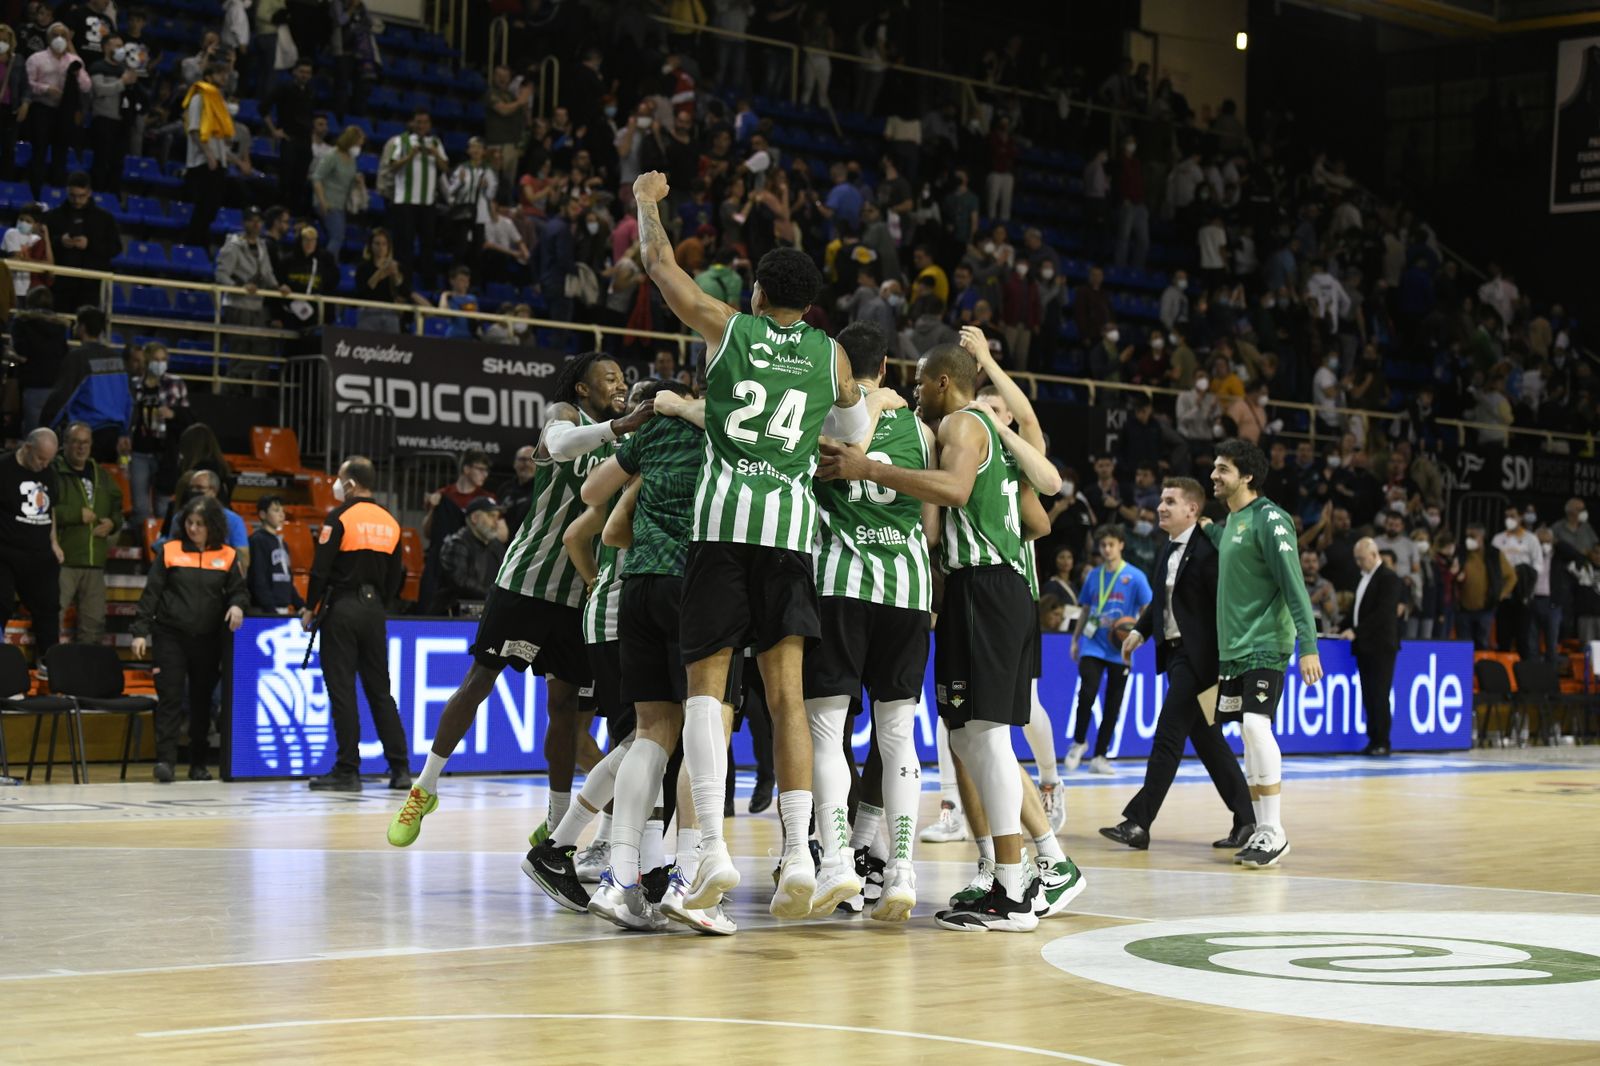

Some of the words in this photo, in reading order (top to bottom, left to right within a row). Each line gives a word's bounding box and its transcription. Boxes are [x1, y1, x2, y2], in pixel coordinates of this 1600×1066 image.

[335, 340, 351, 357] tu
[352, 344, 413, 364] copiadora
[482, 357, 555, 378] SHARP
[724, 379, 808, 453] 24
[396, 433, 499, 454] www.sidicoim.es
[1410, 653, 1463, 734] de
